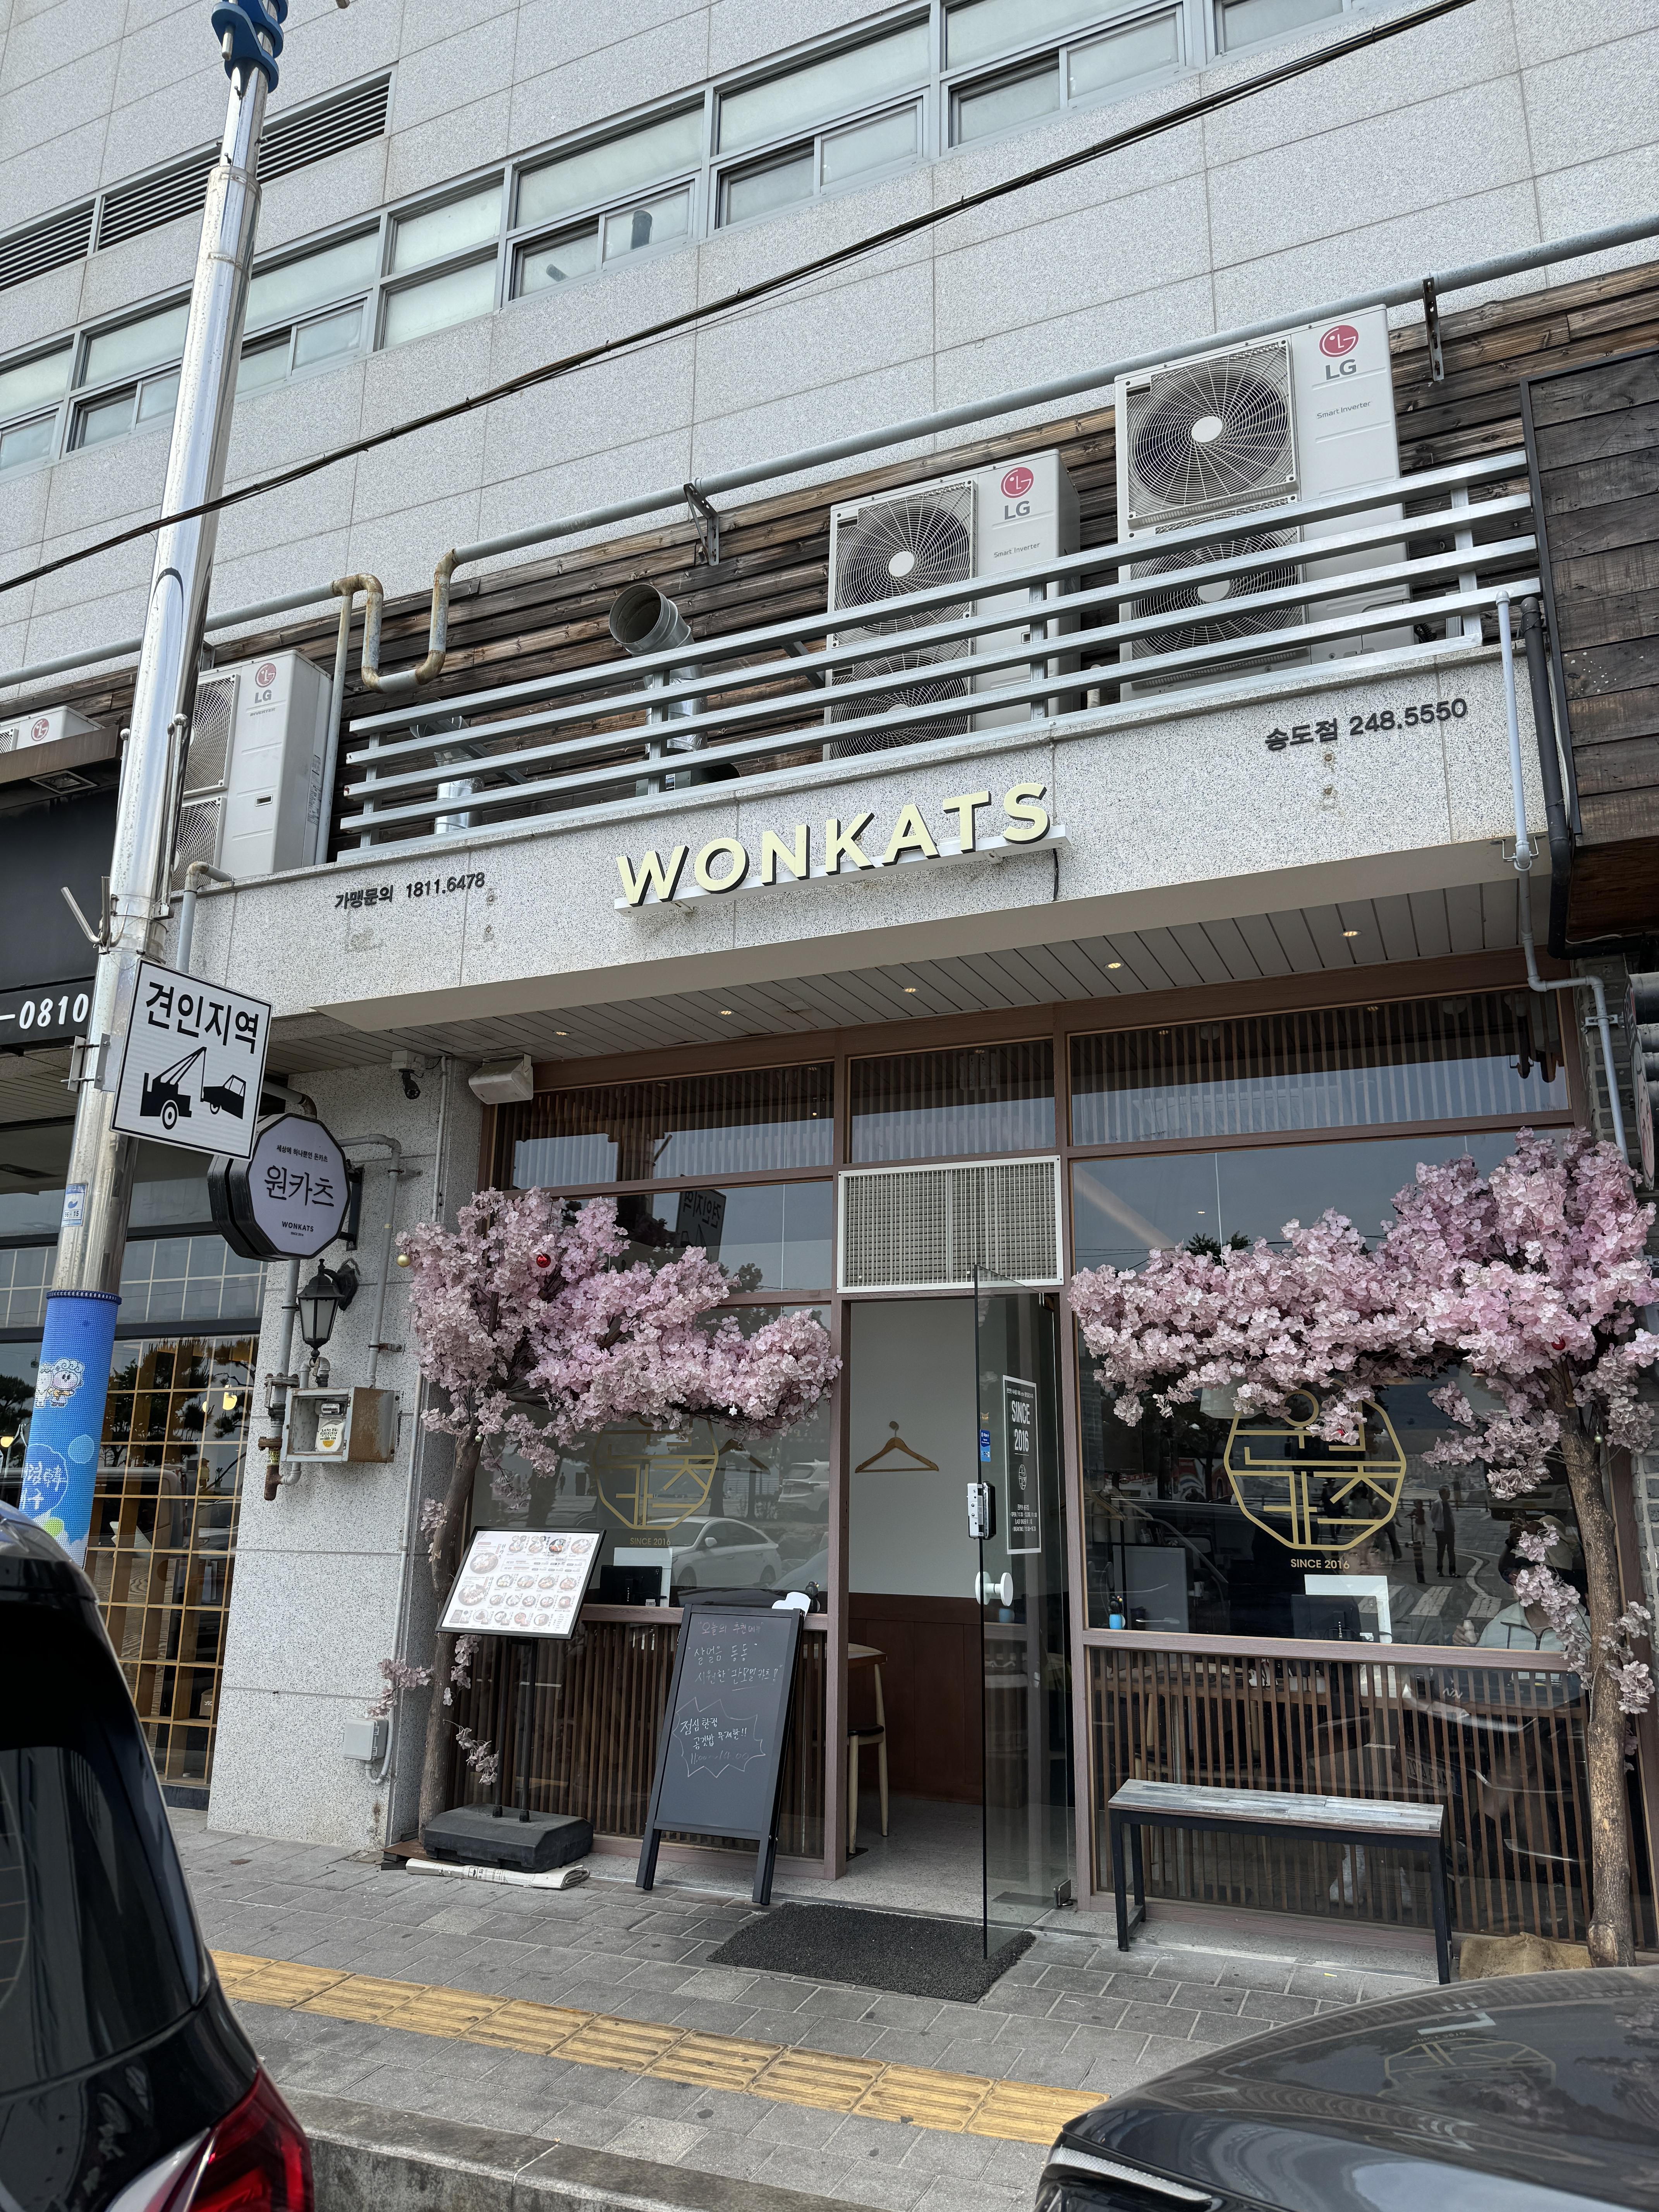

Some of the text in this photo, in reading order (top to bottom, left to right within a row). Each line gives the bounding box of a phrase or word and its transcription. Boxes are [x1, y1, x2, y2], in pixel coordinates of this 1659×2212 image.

[1325, 359, 1357, 380] LG
[1317, 401, 1371, 419] Smart Inverter
[1005, 501, 1030, 520] LG
[994, 543, 1040, 558] Smart Inverter
[254, 689, 272, 704] LG
[1265, 698, 1467, 751] 송도점 248.5550
[616, 781, 1051, 907] WONKATS
[335, 872, 485, 909] 가맹문의 1811.6478
[146, 981, 259, 1054] 견인지역
[276, 1145, 292, 1154] 세상에
[314, 1153, 328, 1162] 돈카츠
[264, 1165, 334, 1207] 원카츠
[282, 1221, 314, 1232] WONKATS
[1012, 1400, 1030, 1424] SINCE
[1014, 1429, 1029, 1452] 2016
[1291, 1559, 1350, 1569] SINCE 2016
[680, 1718, 718, 1735] 점심 한정
[693, 1734, 714, 1750] 공깃밥
